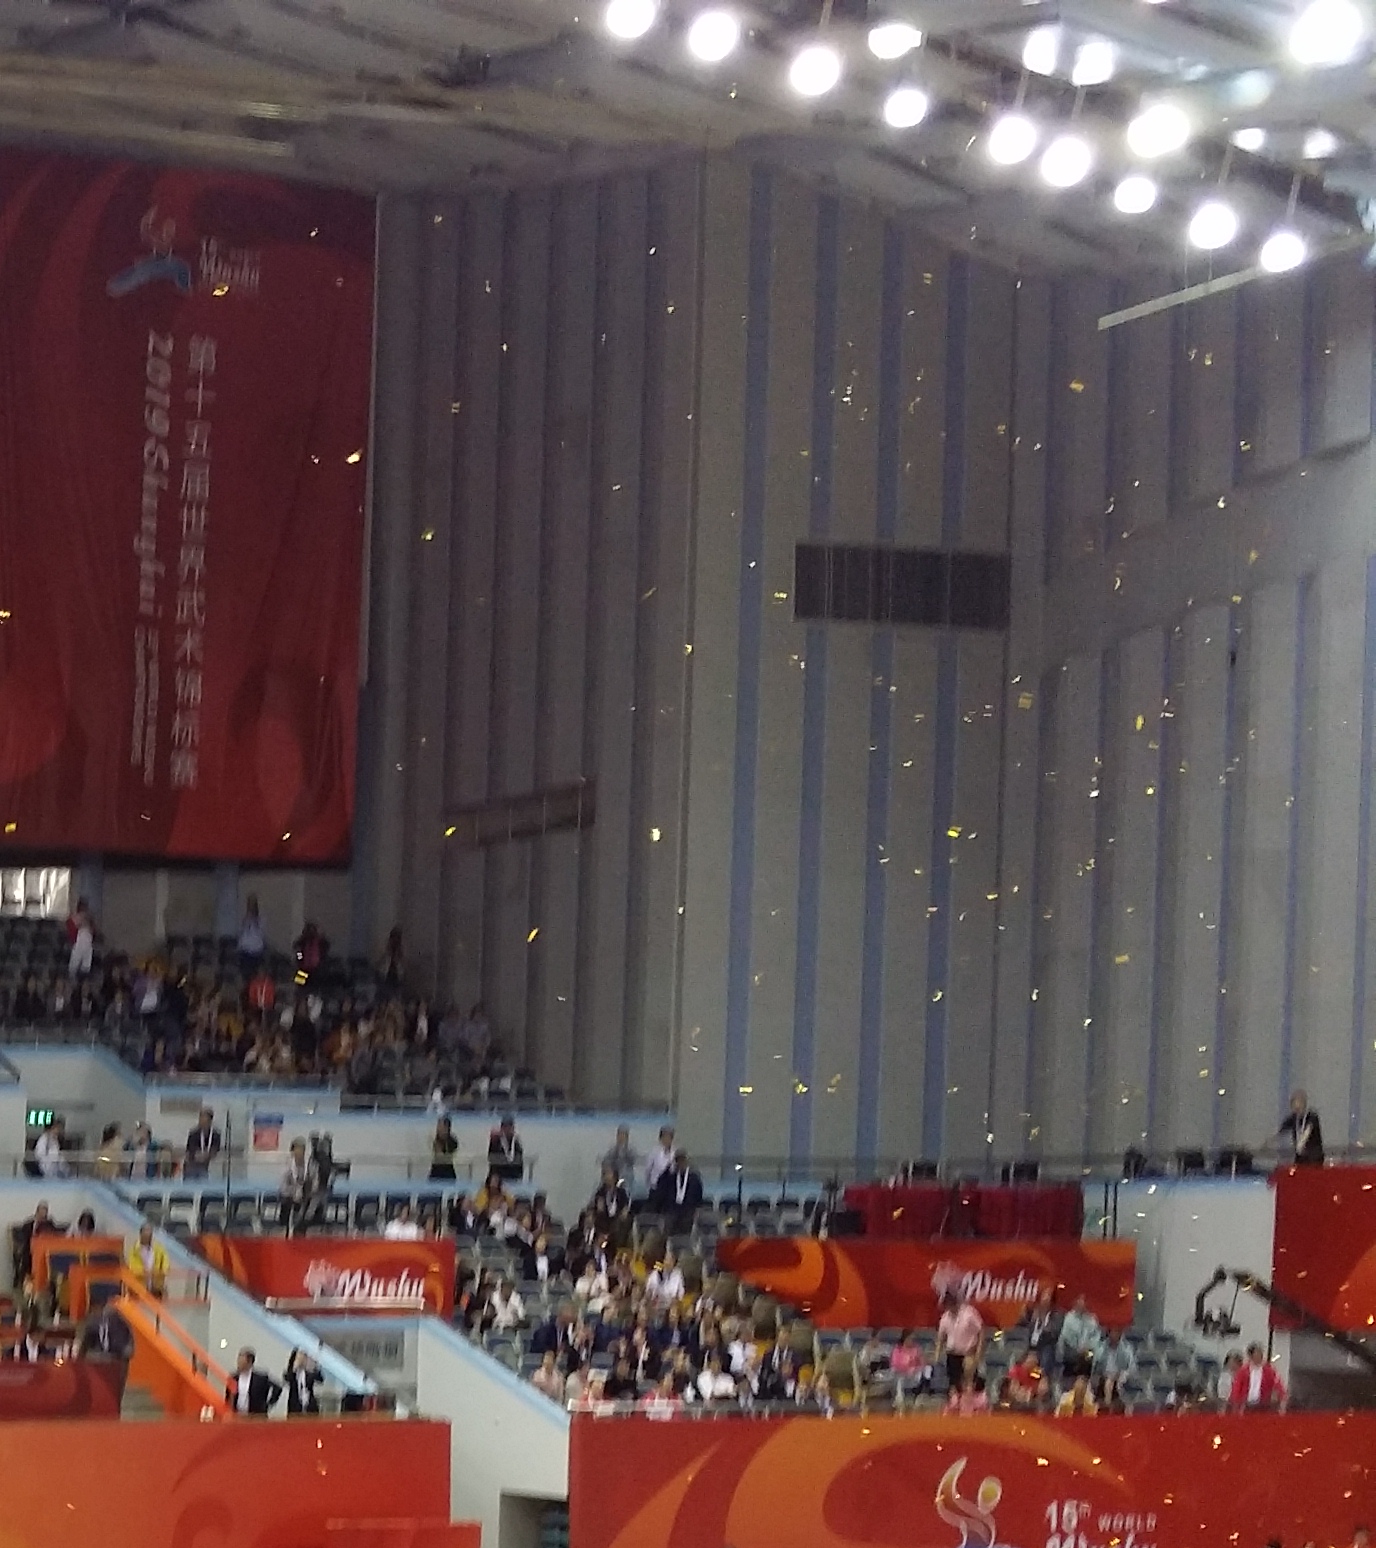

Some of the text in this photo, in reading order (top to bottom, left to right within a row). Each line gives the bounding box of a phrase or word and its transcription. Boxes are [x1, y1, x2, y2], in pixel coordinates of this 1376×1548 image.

[335, 1267, 426, 1302] Wushu
[960, 1268, 1040, 1302] Wushu
[1098, 1512, 1157, 1533] WORLD
